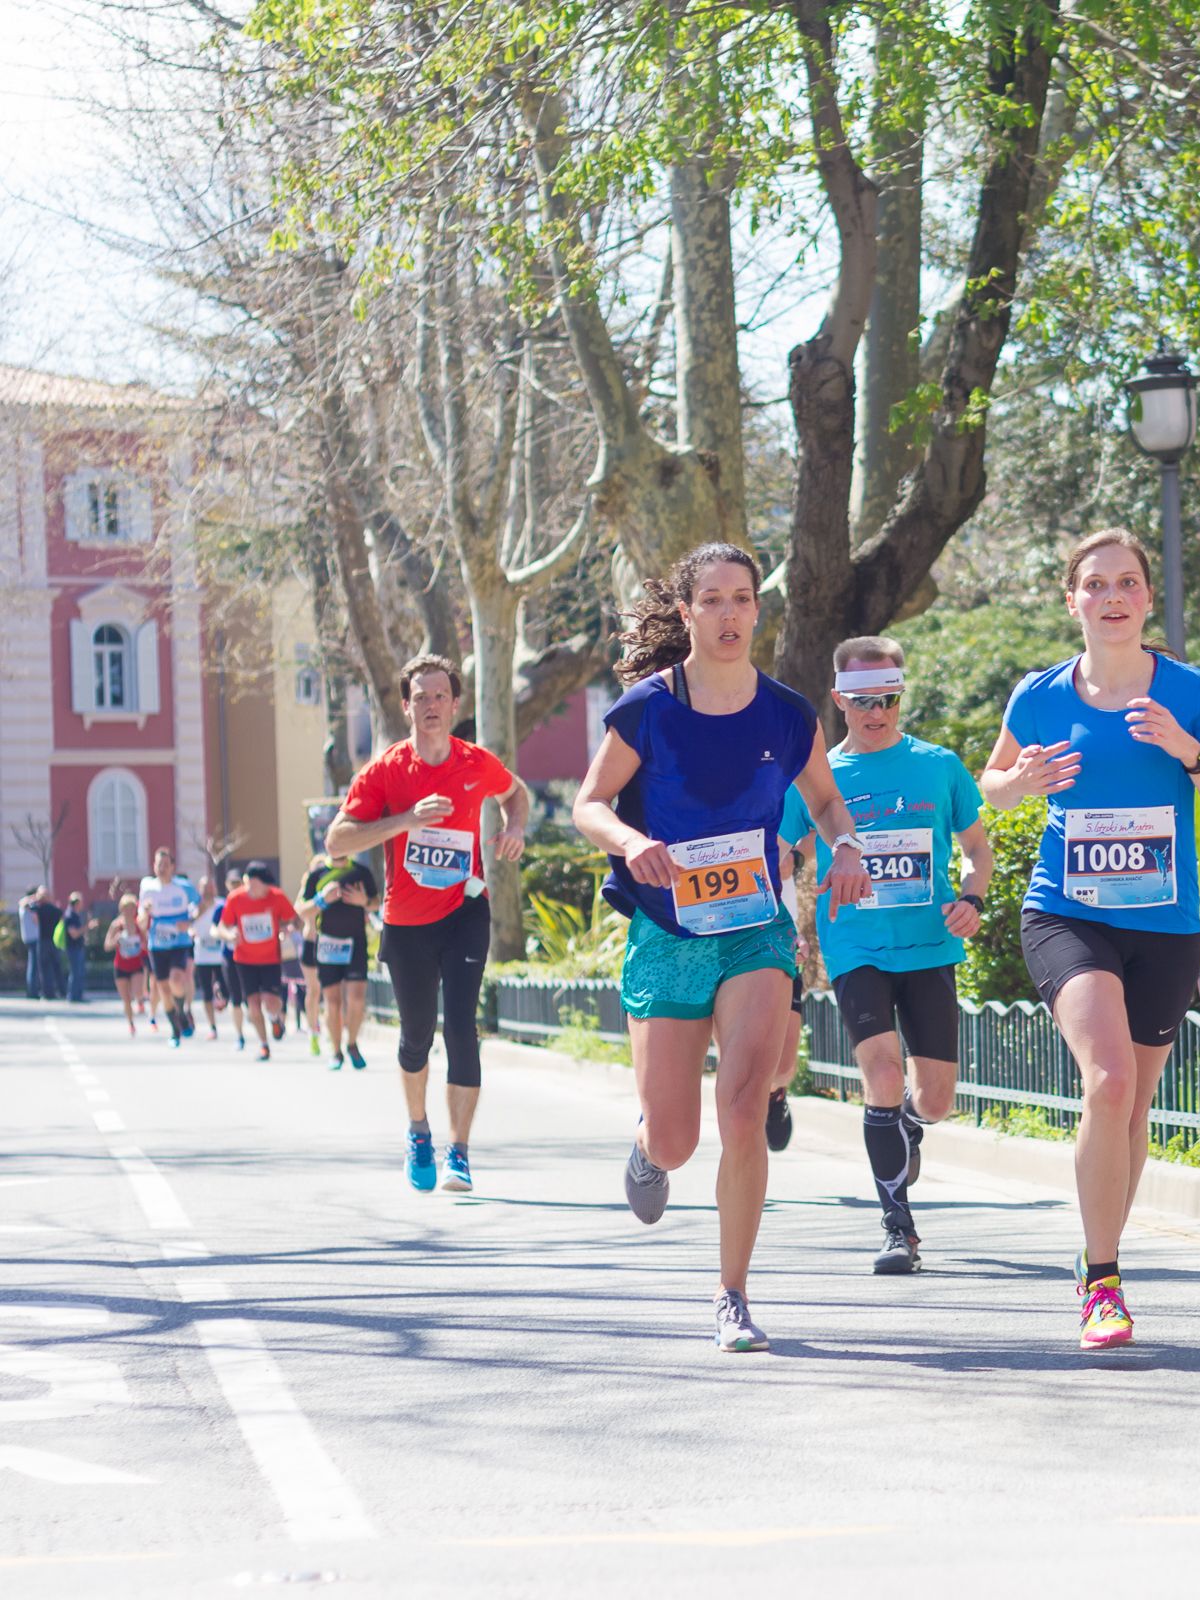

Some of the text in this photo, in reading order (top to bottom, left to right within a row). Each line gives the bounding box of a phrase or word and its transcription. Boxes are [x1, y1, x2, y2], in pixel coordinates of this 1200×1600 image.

[408, 844, 456, 867] 2107
[1073, 842, 1146, 872] 1008
[688, 868, 740, 899] 199
